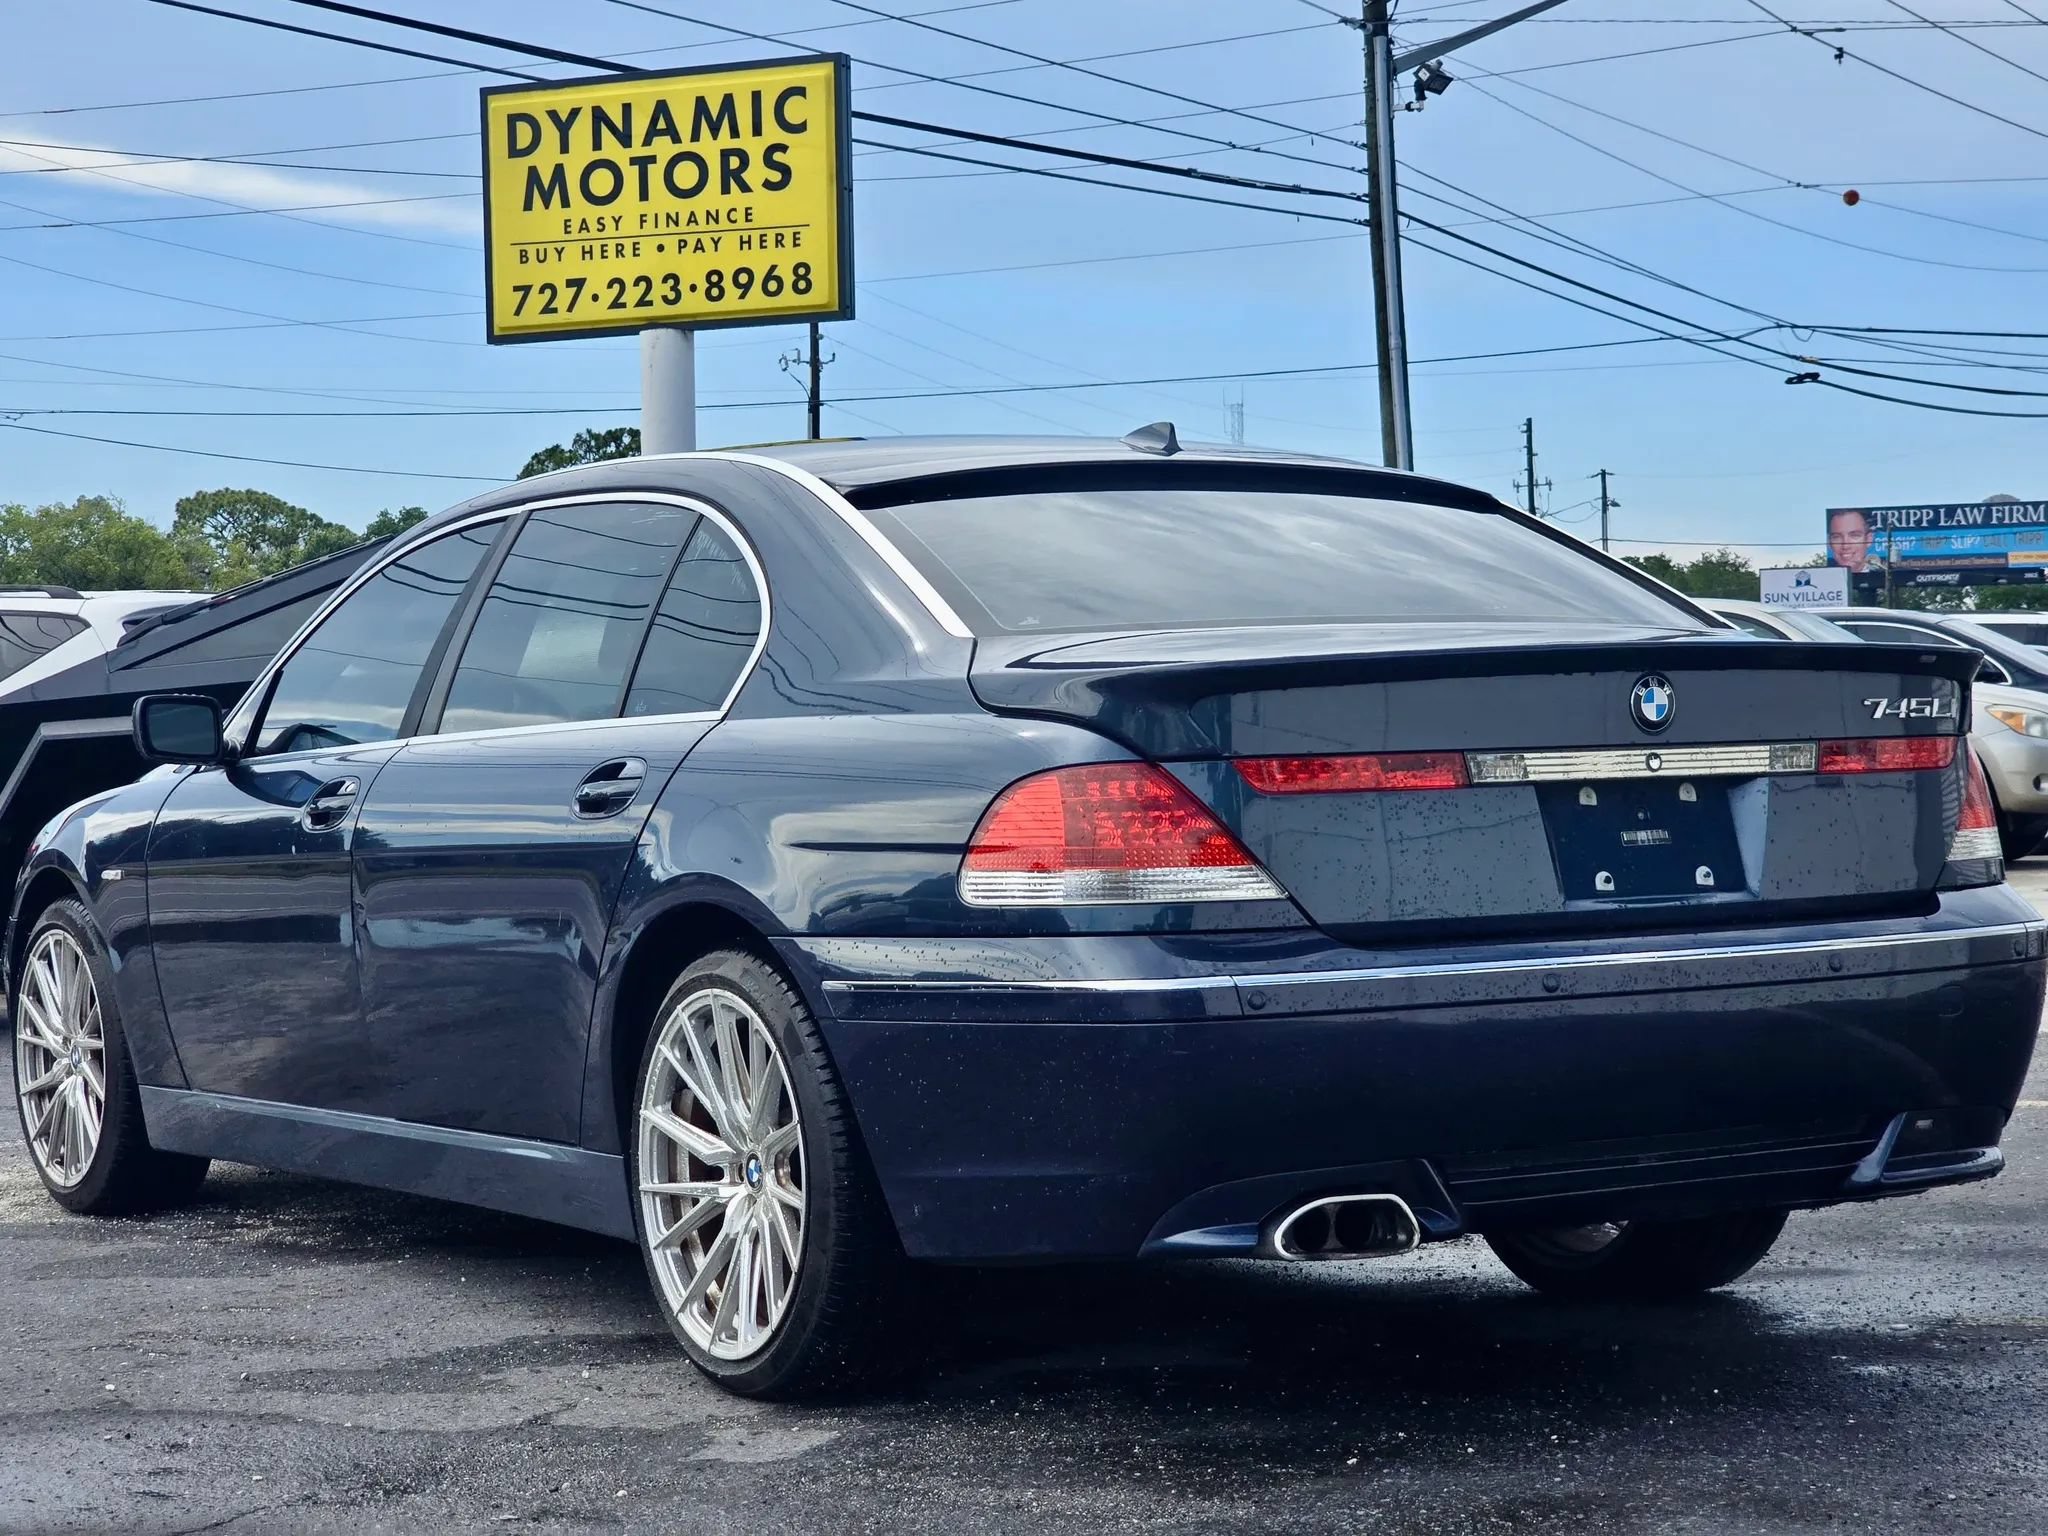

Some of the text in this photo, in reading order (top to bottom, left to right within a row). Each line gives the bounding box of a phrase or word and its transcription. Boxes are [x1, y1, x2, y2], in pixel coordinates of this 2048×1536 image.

[506, 86, 808, 159] DYNAMIC
[522, 143, 792, 212] MOTORS
[563, 206, 754, 235] EASY FINANCE
[519, 231, 802, 265] BUY HERE PAY HERE
[1871, 504, 2046, 529] TRIPP LAW FIRM
[1764, 590, 1843, 604] SUN VILLAGE
[1636, 677, 1671, 696] BMW
